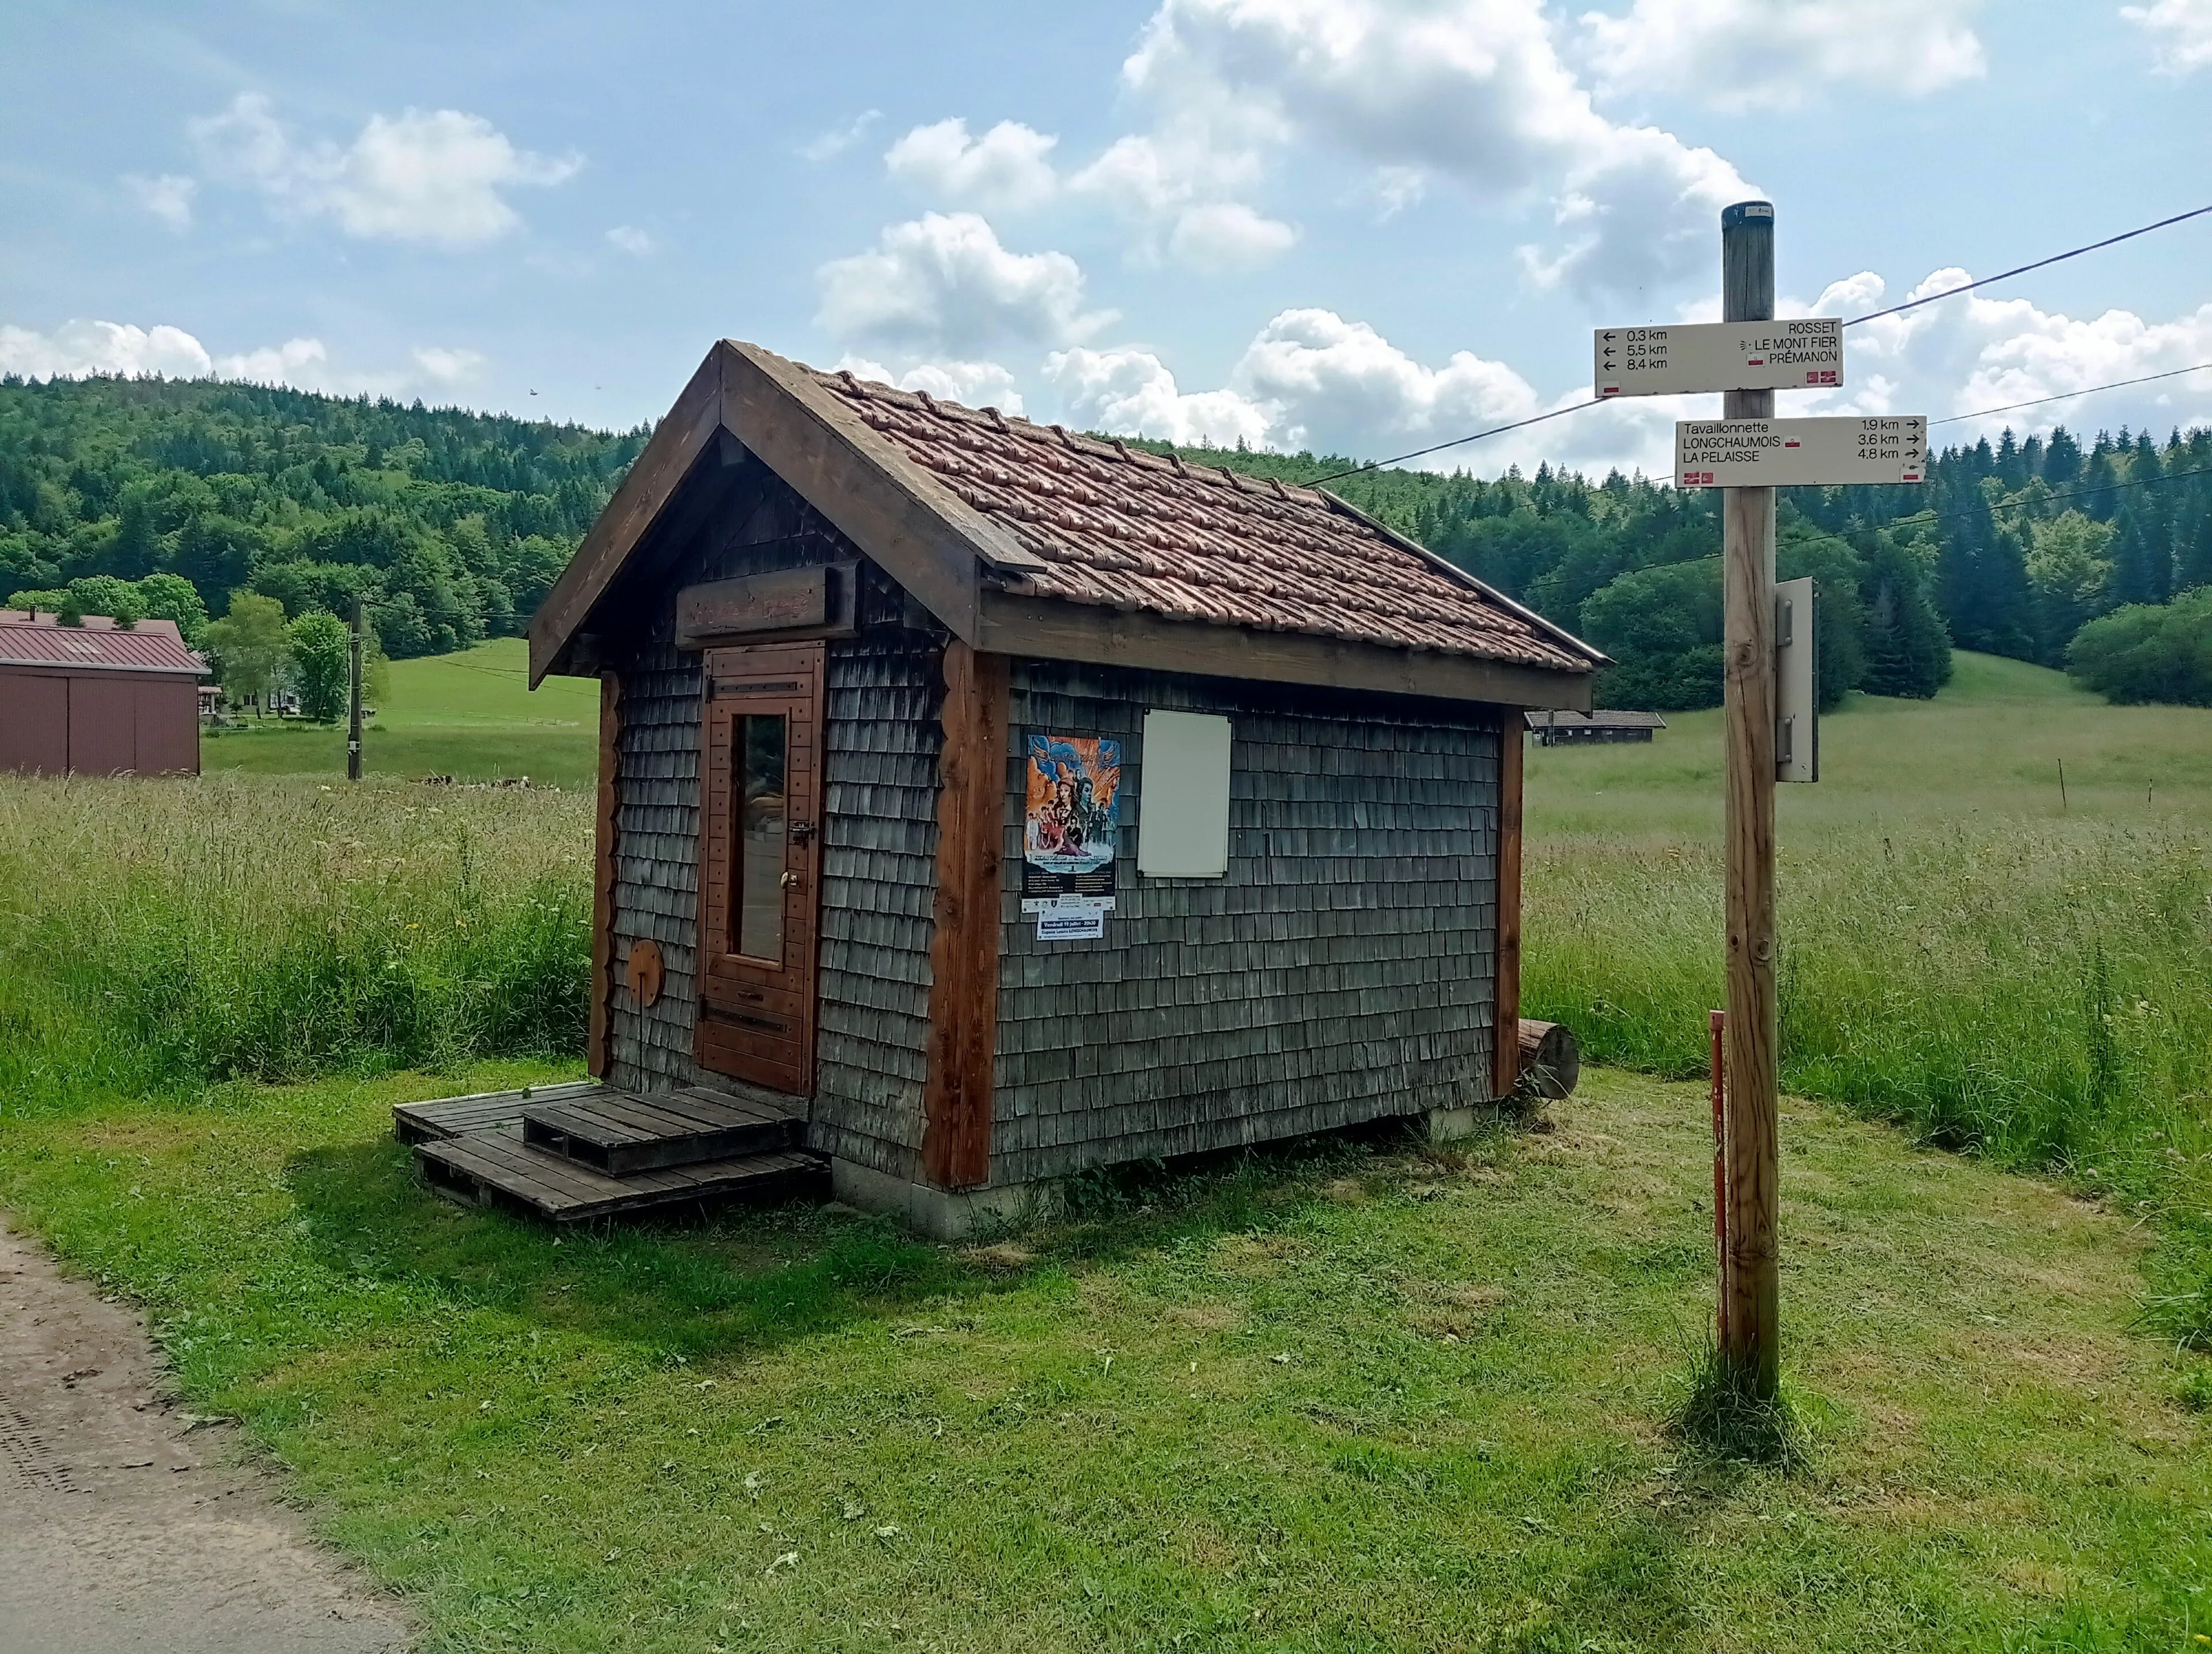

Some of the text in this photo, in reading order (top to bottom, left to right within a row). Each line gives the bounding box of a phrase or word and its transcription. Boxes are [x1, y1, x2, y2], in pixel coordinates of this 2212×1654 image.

[1789, 321, 1836, 334] ROSSET
[1627, 330, 1667, 342] 0.3 km
[1755, 336, 1837, 350] LE MONT FIER
[1627, 344, 1667, 356] 5.5 km
[1770, 350, 1837, 363] PRÉMANON
[1627, 358, 1667, 370] 8.4 km
[1684, 422, 1768, 434] Tavaillonnette
[1862, 419, 1899, 430] 1.9 km
[1683, 436, 1781, 449] LONGCHAUMOIS
[1858, 434, 1899, 445] 3.6 km
[1683, 451, 1760, 463] LA PELAISSE
[1858, 449, 1899, 459] 4.8 km
